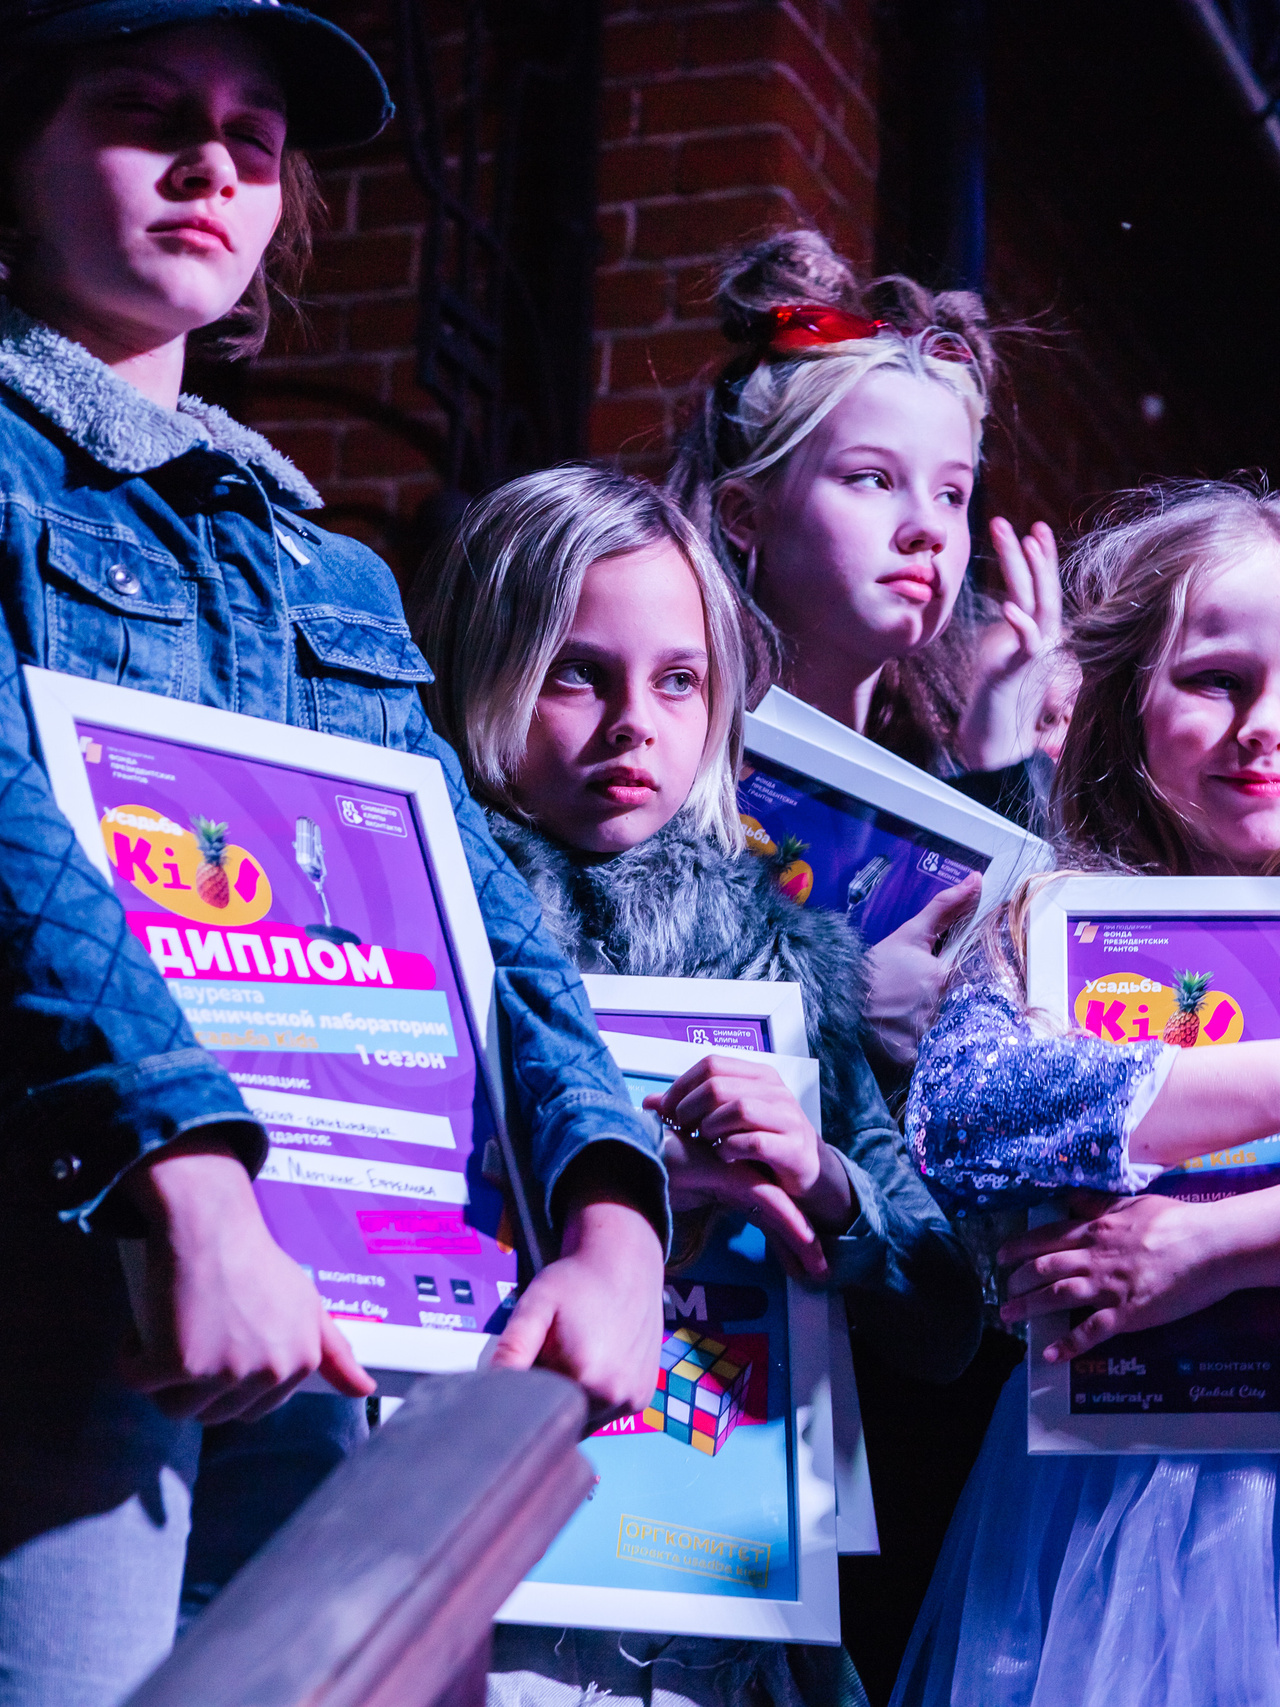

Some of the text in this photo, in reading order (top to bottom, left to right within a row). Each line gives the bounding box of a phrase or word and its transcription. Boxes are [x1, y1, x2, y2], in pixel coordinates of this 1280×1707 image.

[103, 806, 184, 836] Усадьба
[146, 926, 393, 985] ДИПЛОМ
[167, 981, 265, 1005] Лауреата
[1085, 979, 1162, 994] Усадьба
[184, 1007, 448, 1038] ценической лаборатории
[195, 1029, 270, 1046] садьба
[355, 1044, 447, 1069] 1 сезон
[229, 1072, 311, 1090] минации:
[1210, 1148, 1257, 1166] Kids
[1189, 1384, 1267, 1402] Global City
[626, 1522, 765, 1563] ОРГКОМИТЕТ
